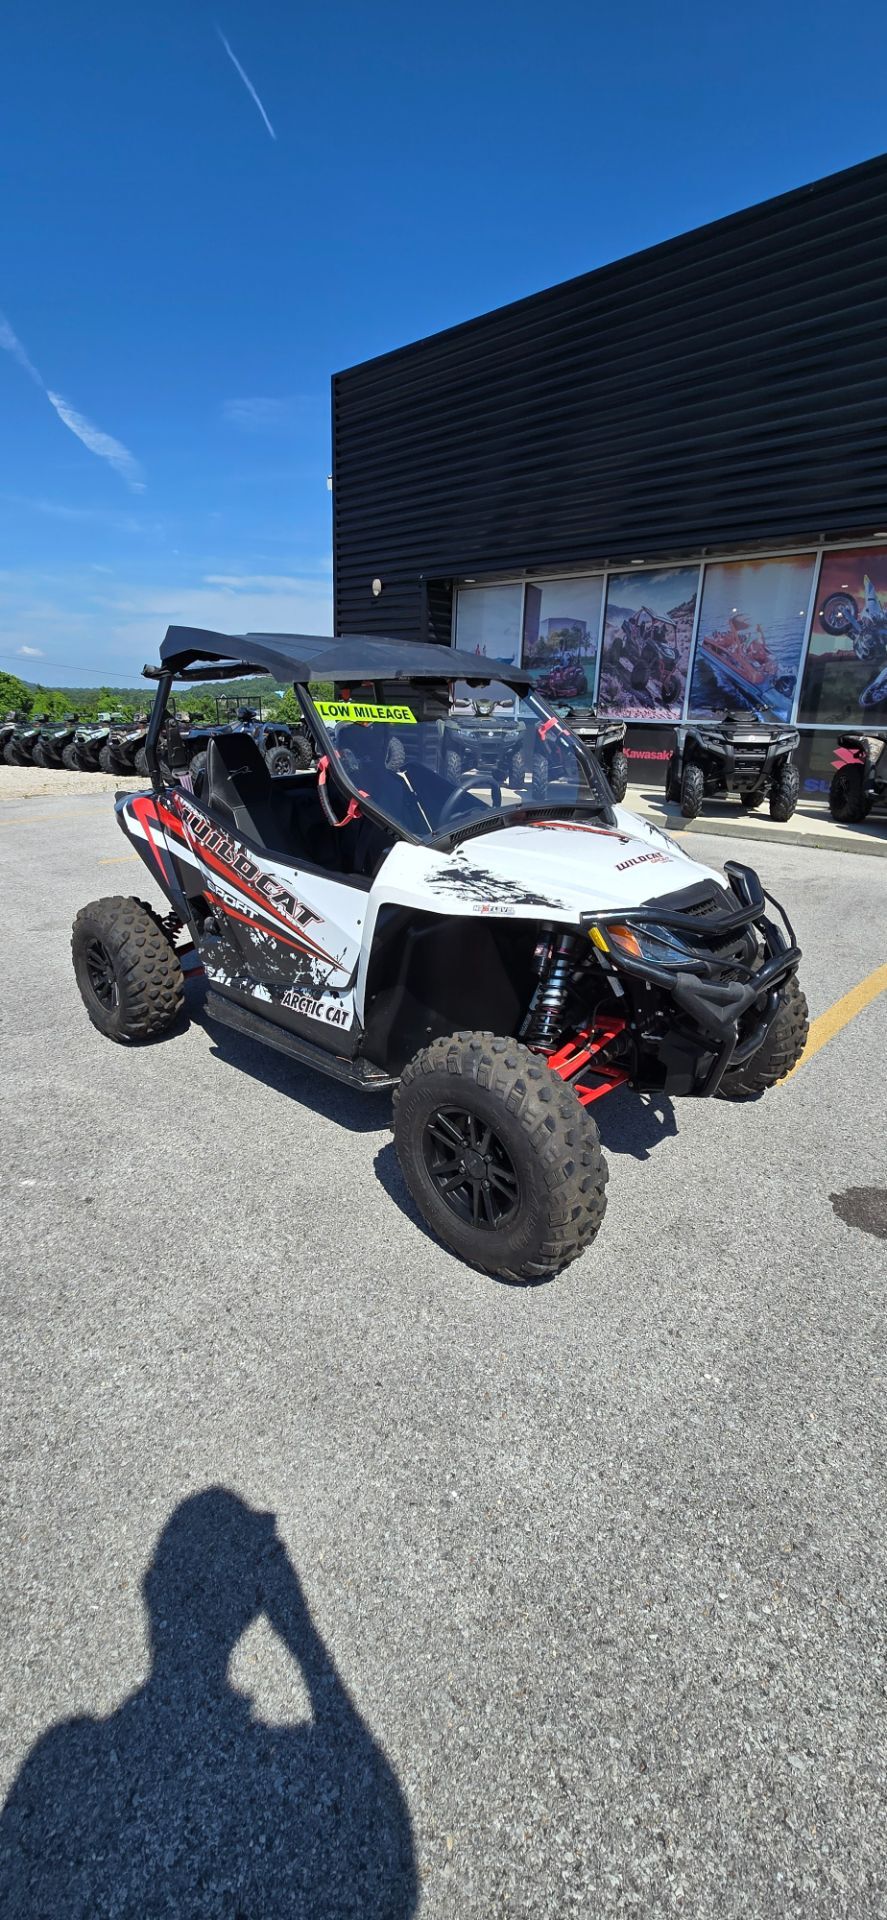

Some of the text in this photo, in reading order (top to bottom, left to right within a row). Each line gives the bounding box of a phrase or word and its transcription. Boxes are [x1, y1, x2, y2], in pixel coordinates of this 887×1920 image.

[320, 704, 411, 720] LOW MILEAGE
[181, 807, 326, 928] WILDCAT
[614, 852, 664, 871] WILDCAT
[206, 879, 259, 919] SPORT
[282, 992, 350, 1026] ARCTIC CAT
